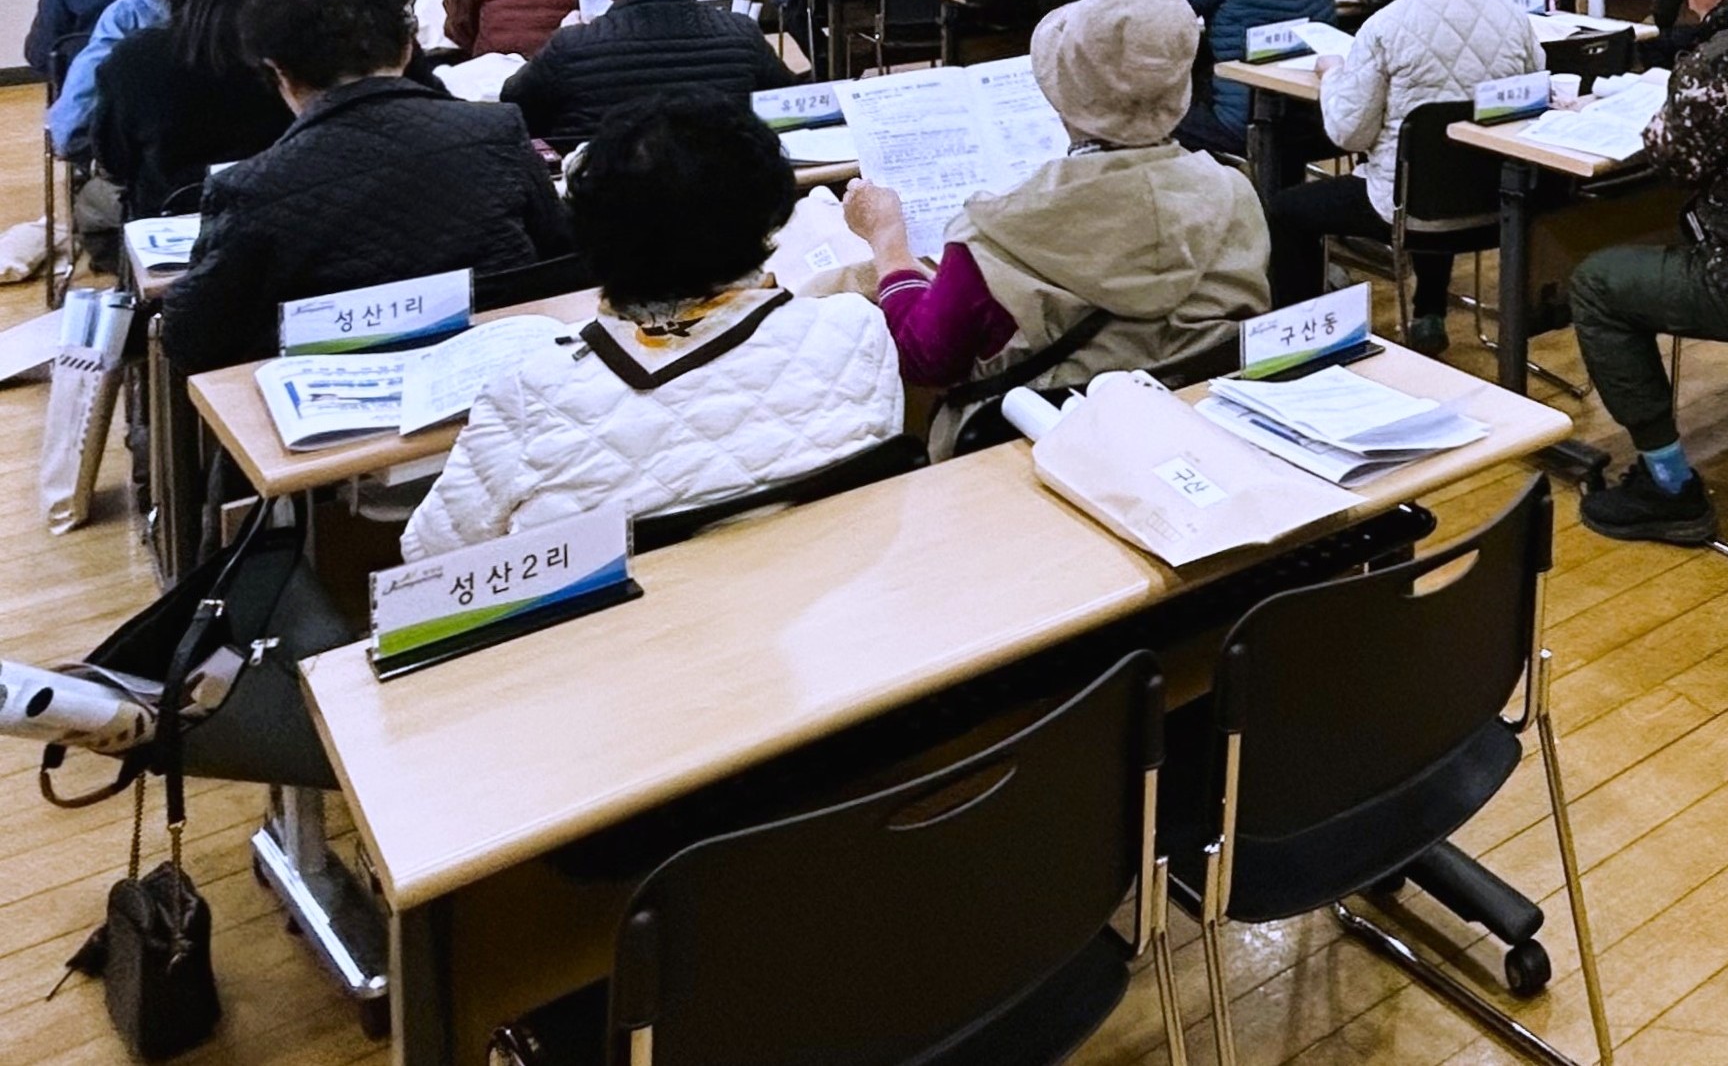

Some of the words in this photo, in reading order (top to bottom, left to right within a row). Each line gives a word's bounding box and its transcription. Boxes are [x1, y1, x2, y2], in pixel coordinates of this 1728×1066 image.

[334, 295, 423, 333] 성산1리
[1280, 312, 1338, 346] 구산동
[450, 543, 569, 606] 성산2리
